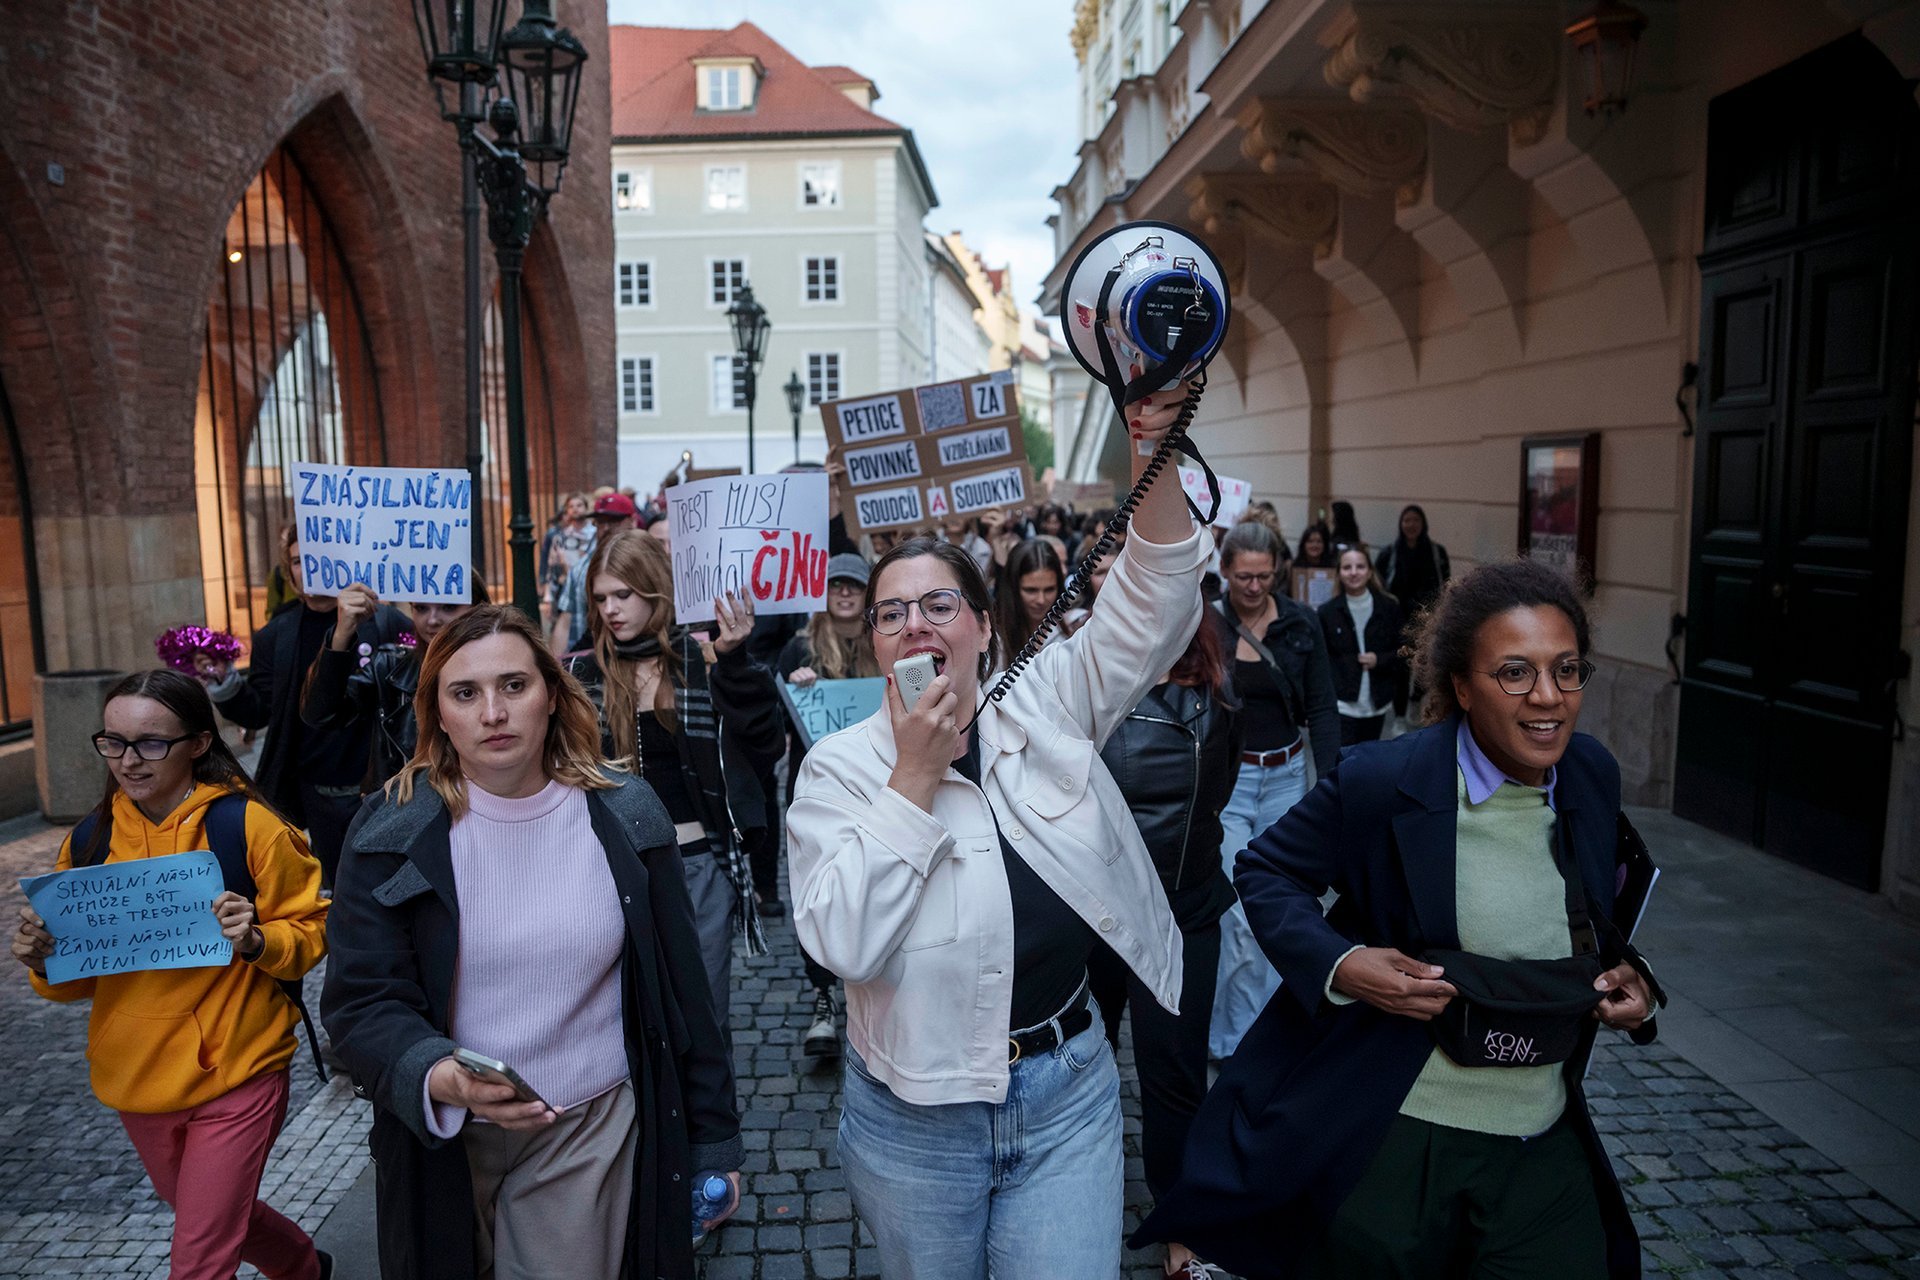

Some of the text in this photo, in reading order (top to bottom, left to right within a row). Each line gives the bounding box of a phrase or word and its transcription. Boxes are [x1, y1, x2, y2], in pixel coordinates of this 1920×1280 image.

[843, 385, 999, 436] PETICE ZA
[850, 443, 917, 482] POVINNÉ
[672, 477, 789, 537] TREST MUSÍ
[860, 469, 1021, 525] SOUDCŮ A SOUDKYŇ
[305, 511, 364, 546] NENÍ
[304, 554, 464, 596] PODMÍNKA
[751, 529, 828, 602] ČINU
[792, 687, 825, 709] ZA
[56, 862, 214, 900] SEXUÁLNÍ NÁSILÍ
[87, 913, 120, 928] BEZ
[56, 921, 198, 958] ŽÁDNÉ NÁSILÍ
[79, 949, 141, 972] NENÍ
[1484, 1029, 1534, 1050] KON
[1484, 1044, 1543, 1063] SENT
